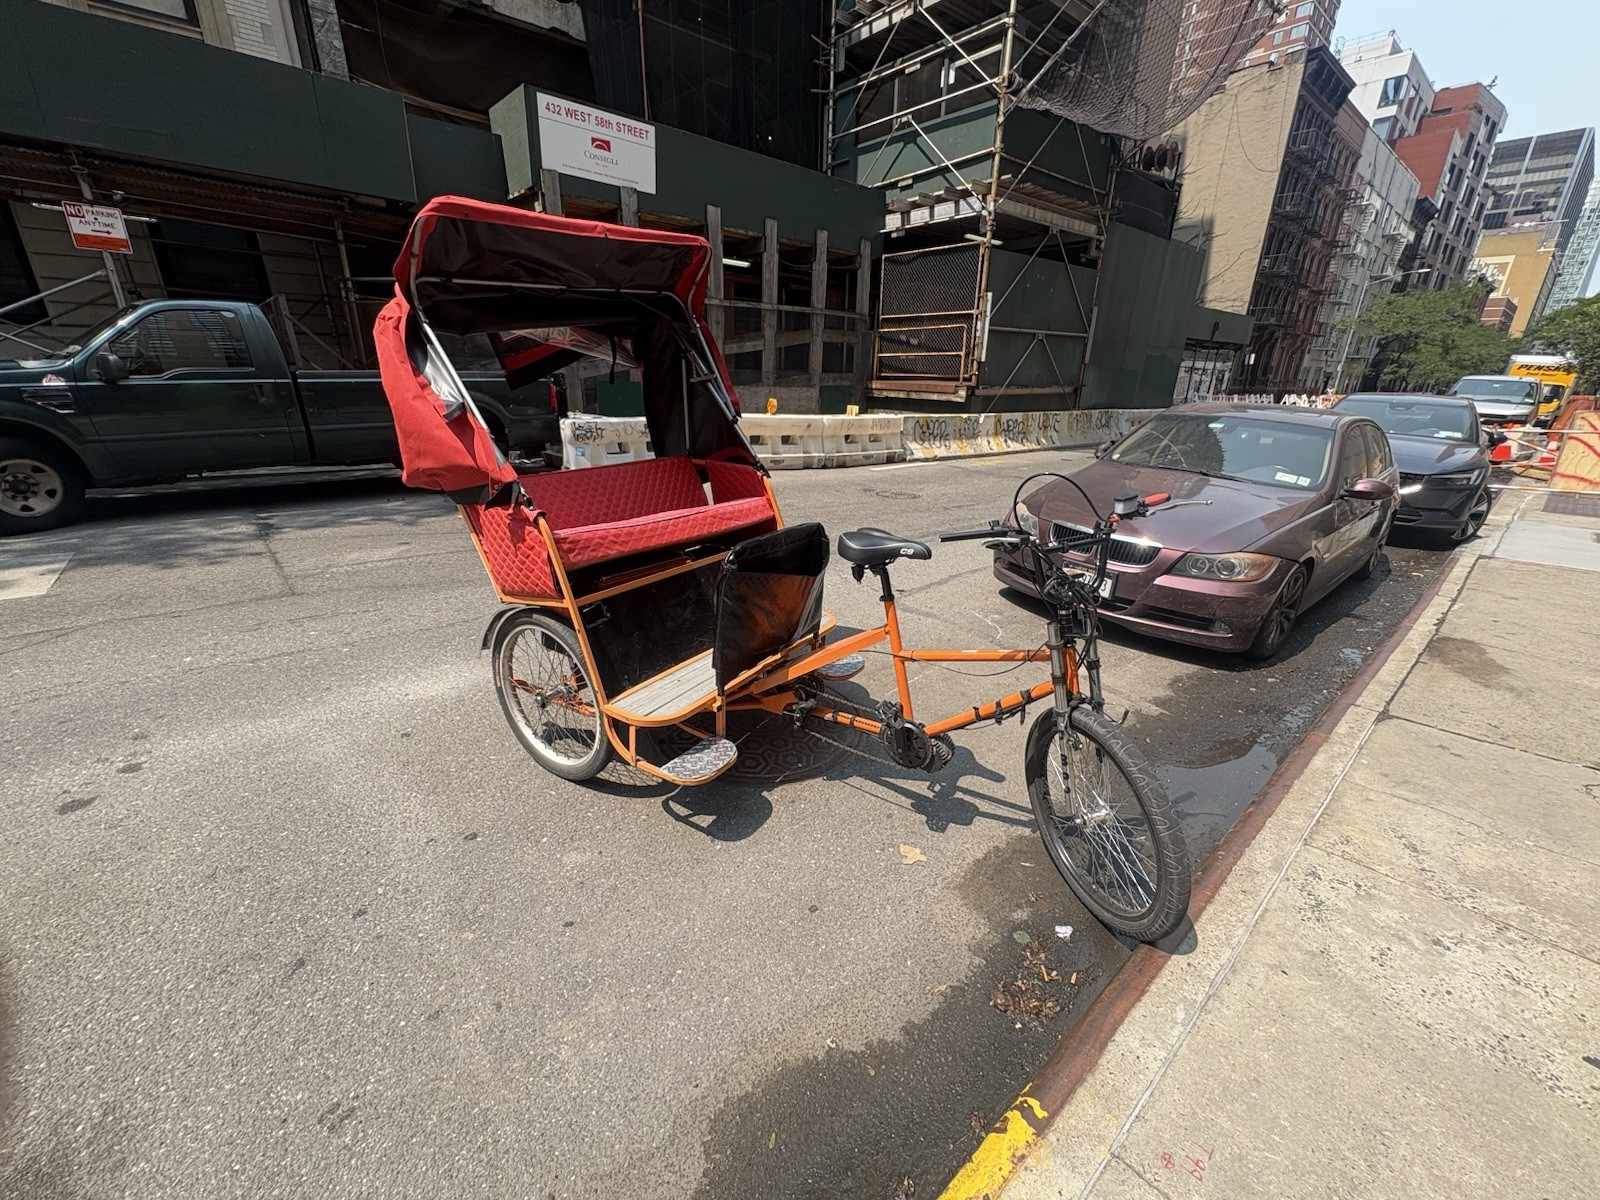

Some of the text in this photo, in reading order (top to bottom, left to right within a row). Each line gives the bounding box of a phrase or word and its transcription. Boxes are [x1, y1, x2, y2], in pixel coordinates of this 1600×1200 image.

[545, 102, 650, 140] 432 WEST 58th STREET
[584, 150, 619, 166] CONSIGLI
[65, 204, 118, 219] NO PARKING
[78, 219, 117, 229] ANYTIME
